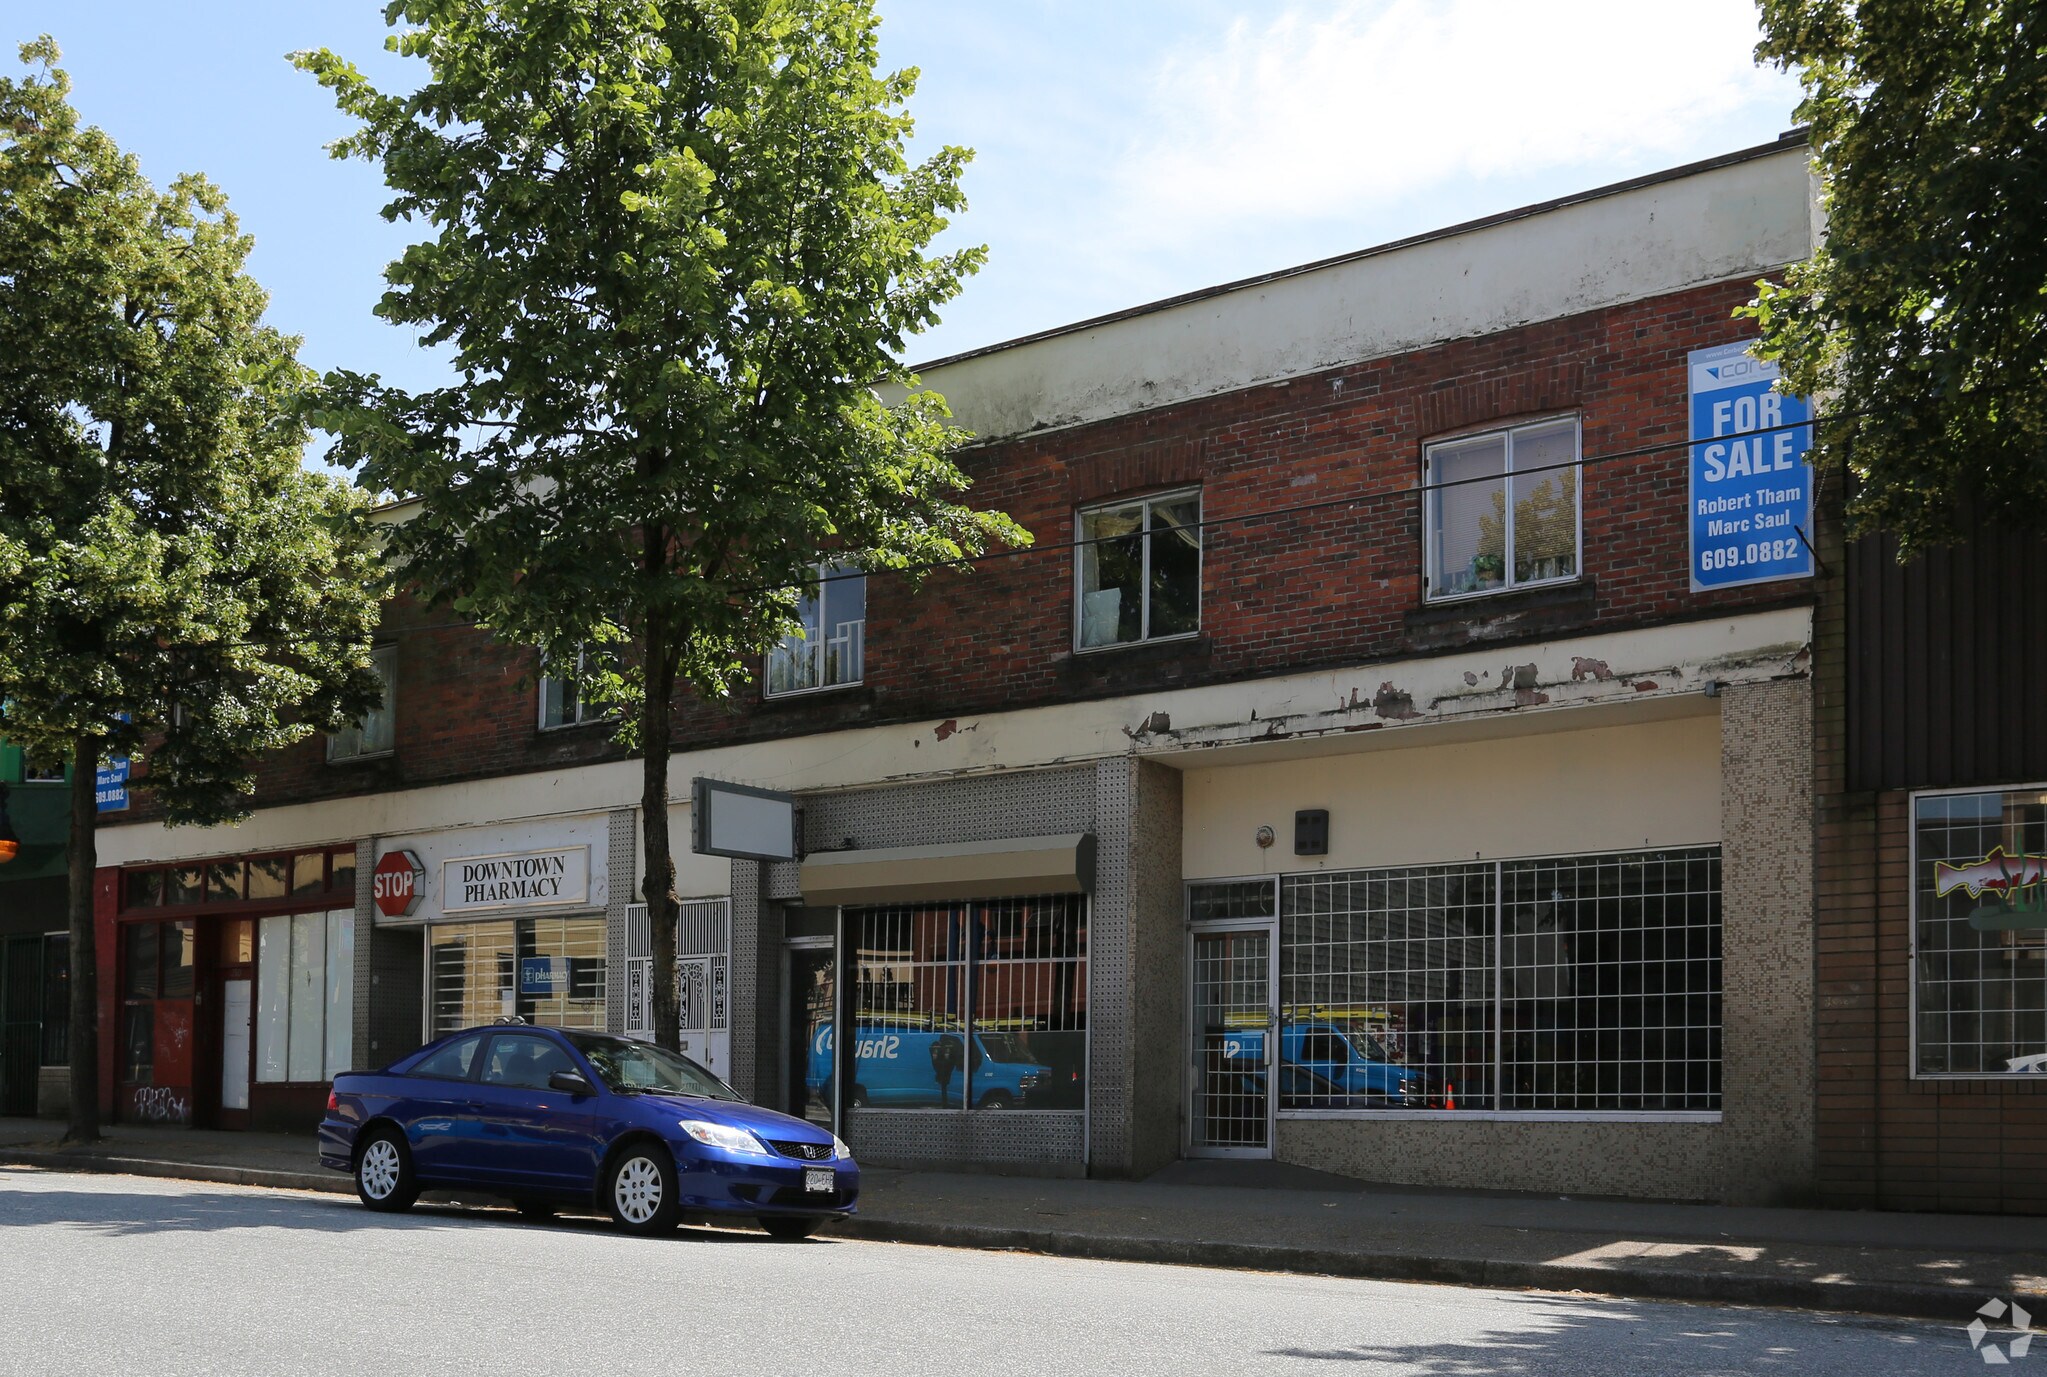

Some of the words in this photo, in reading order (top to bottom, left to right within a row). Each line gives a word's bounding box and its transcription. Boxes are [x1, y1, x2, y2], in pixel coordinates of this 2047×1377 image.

[1712, 393, 1783, 438] FOR
[1703, 432, 1793, 482] SALE
[1698, 492, 1751, 515] Robert
[1756, 486, 1800, 506] Tham
[1708, 518, 1750, 537] Marc
[1755, 509, 1790, 530] Saul
[1701, 538, 1798, 571] 609.0882
[463, 855, 565, 883] DOWNTOWN
[374, 870, 414, 899] STOP
[464, 877, 562, 902] PHARMACY
